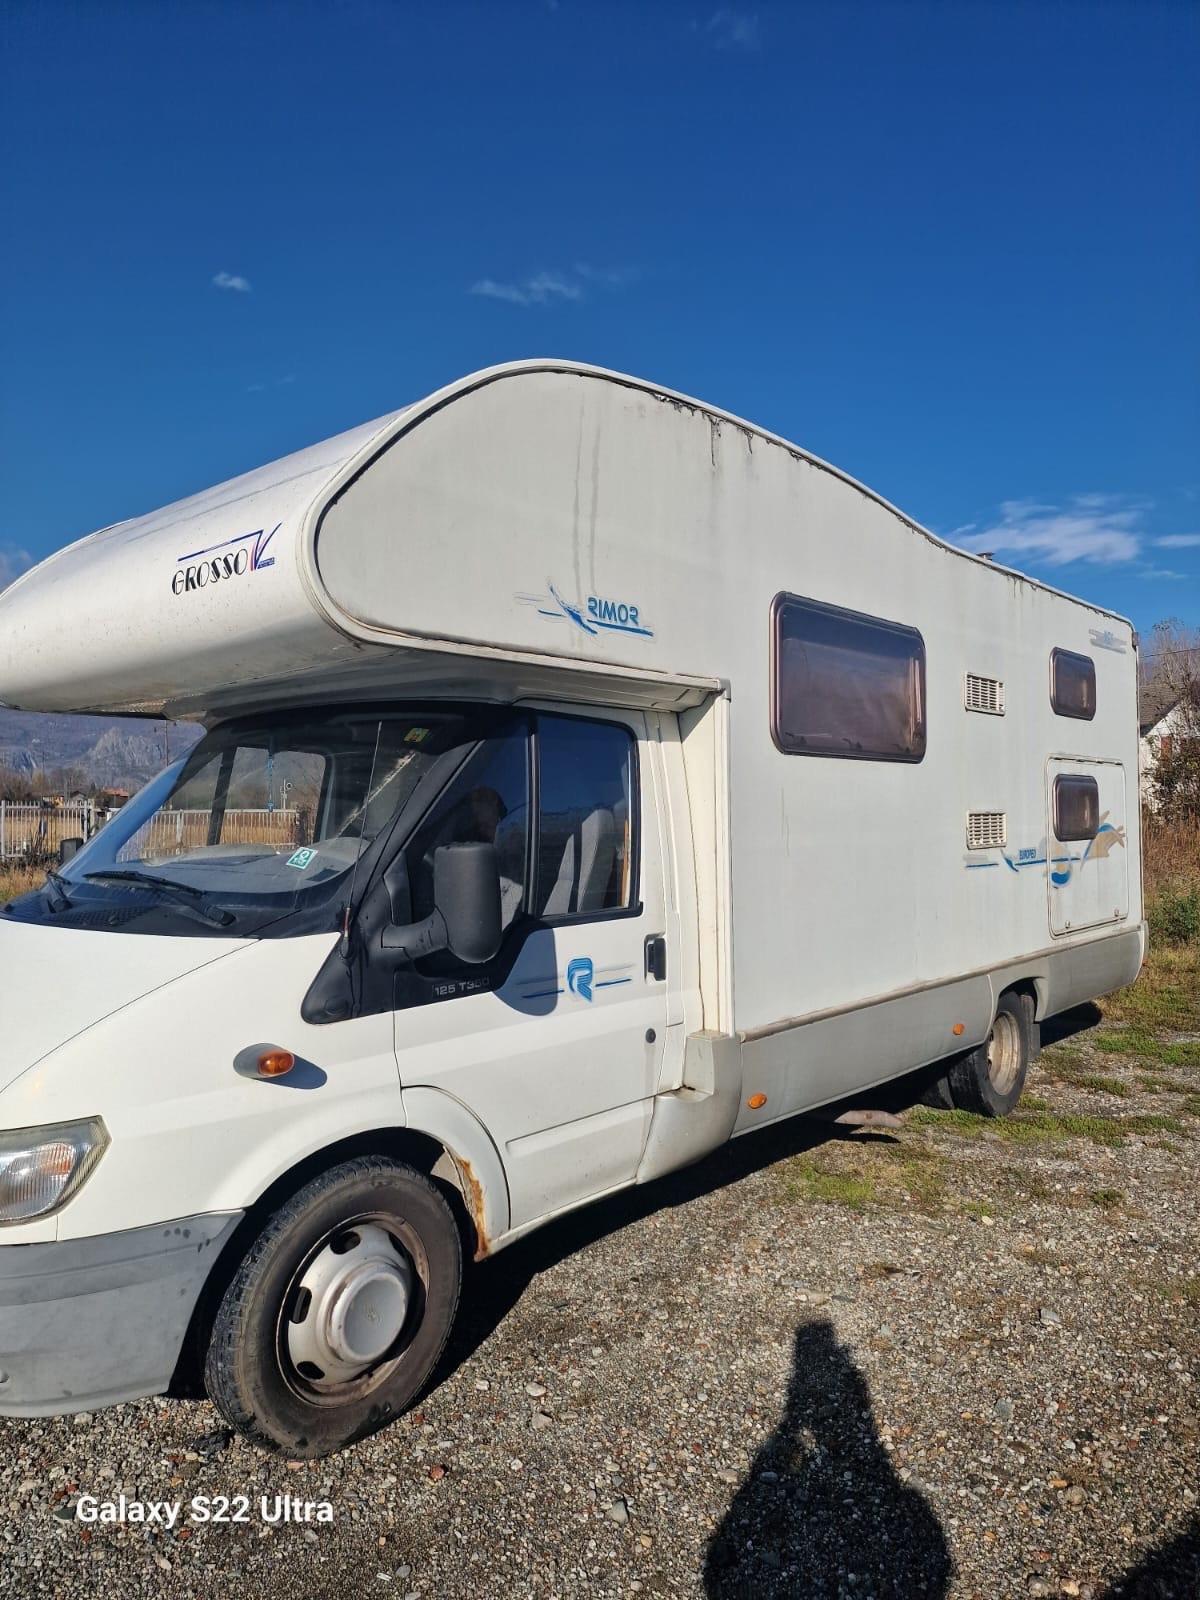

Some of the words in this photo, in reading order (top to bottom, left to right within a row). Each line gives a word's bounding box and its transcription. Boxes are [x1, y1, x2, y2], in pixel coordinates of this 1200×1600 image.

[172, 548, 249, 595] GROSSO
[587, 596, 640, 626] RIMOR
[434, 983, 456, 996] 125
